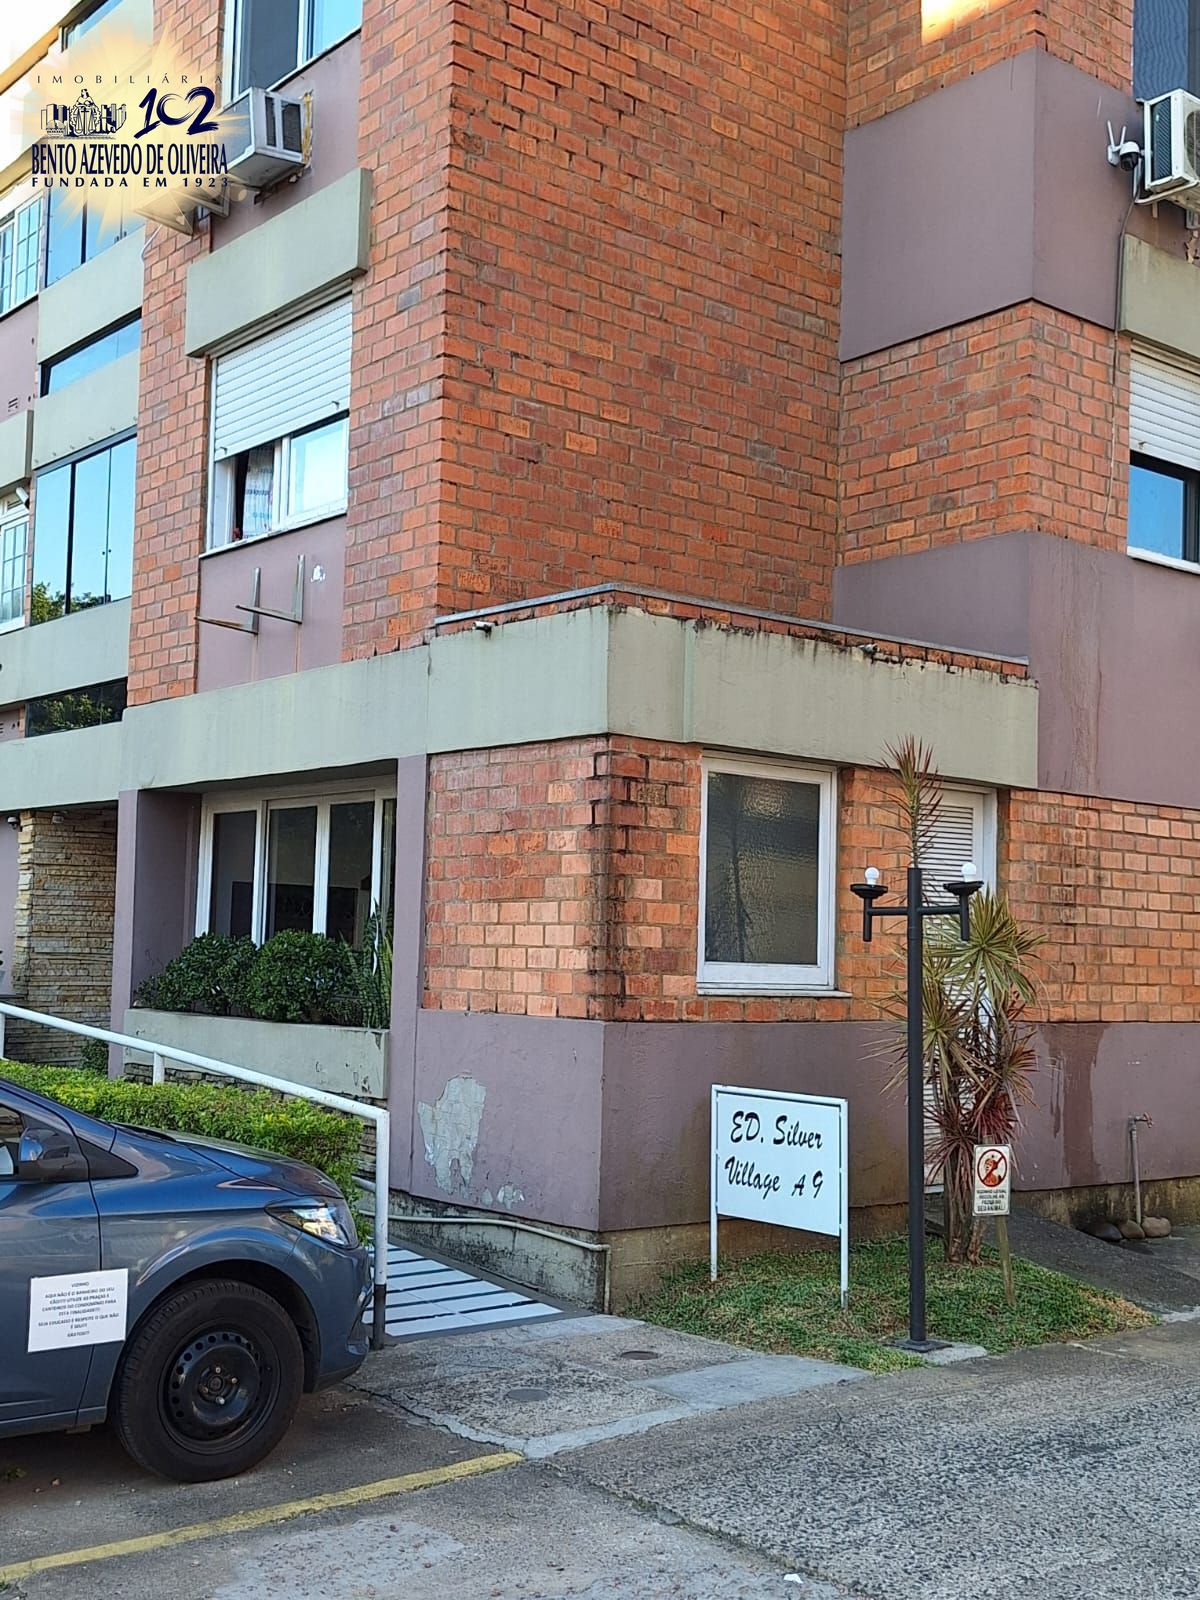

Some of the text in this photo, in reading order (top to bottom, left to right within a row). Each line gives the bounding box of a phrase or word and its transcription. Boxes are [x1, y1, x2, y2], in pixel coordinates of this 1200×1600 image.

[730, 1110, 823, 1149] ED. Silver
[724, 1156, 781, 1200] Village
